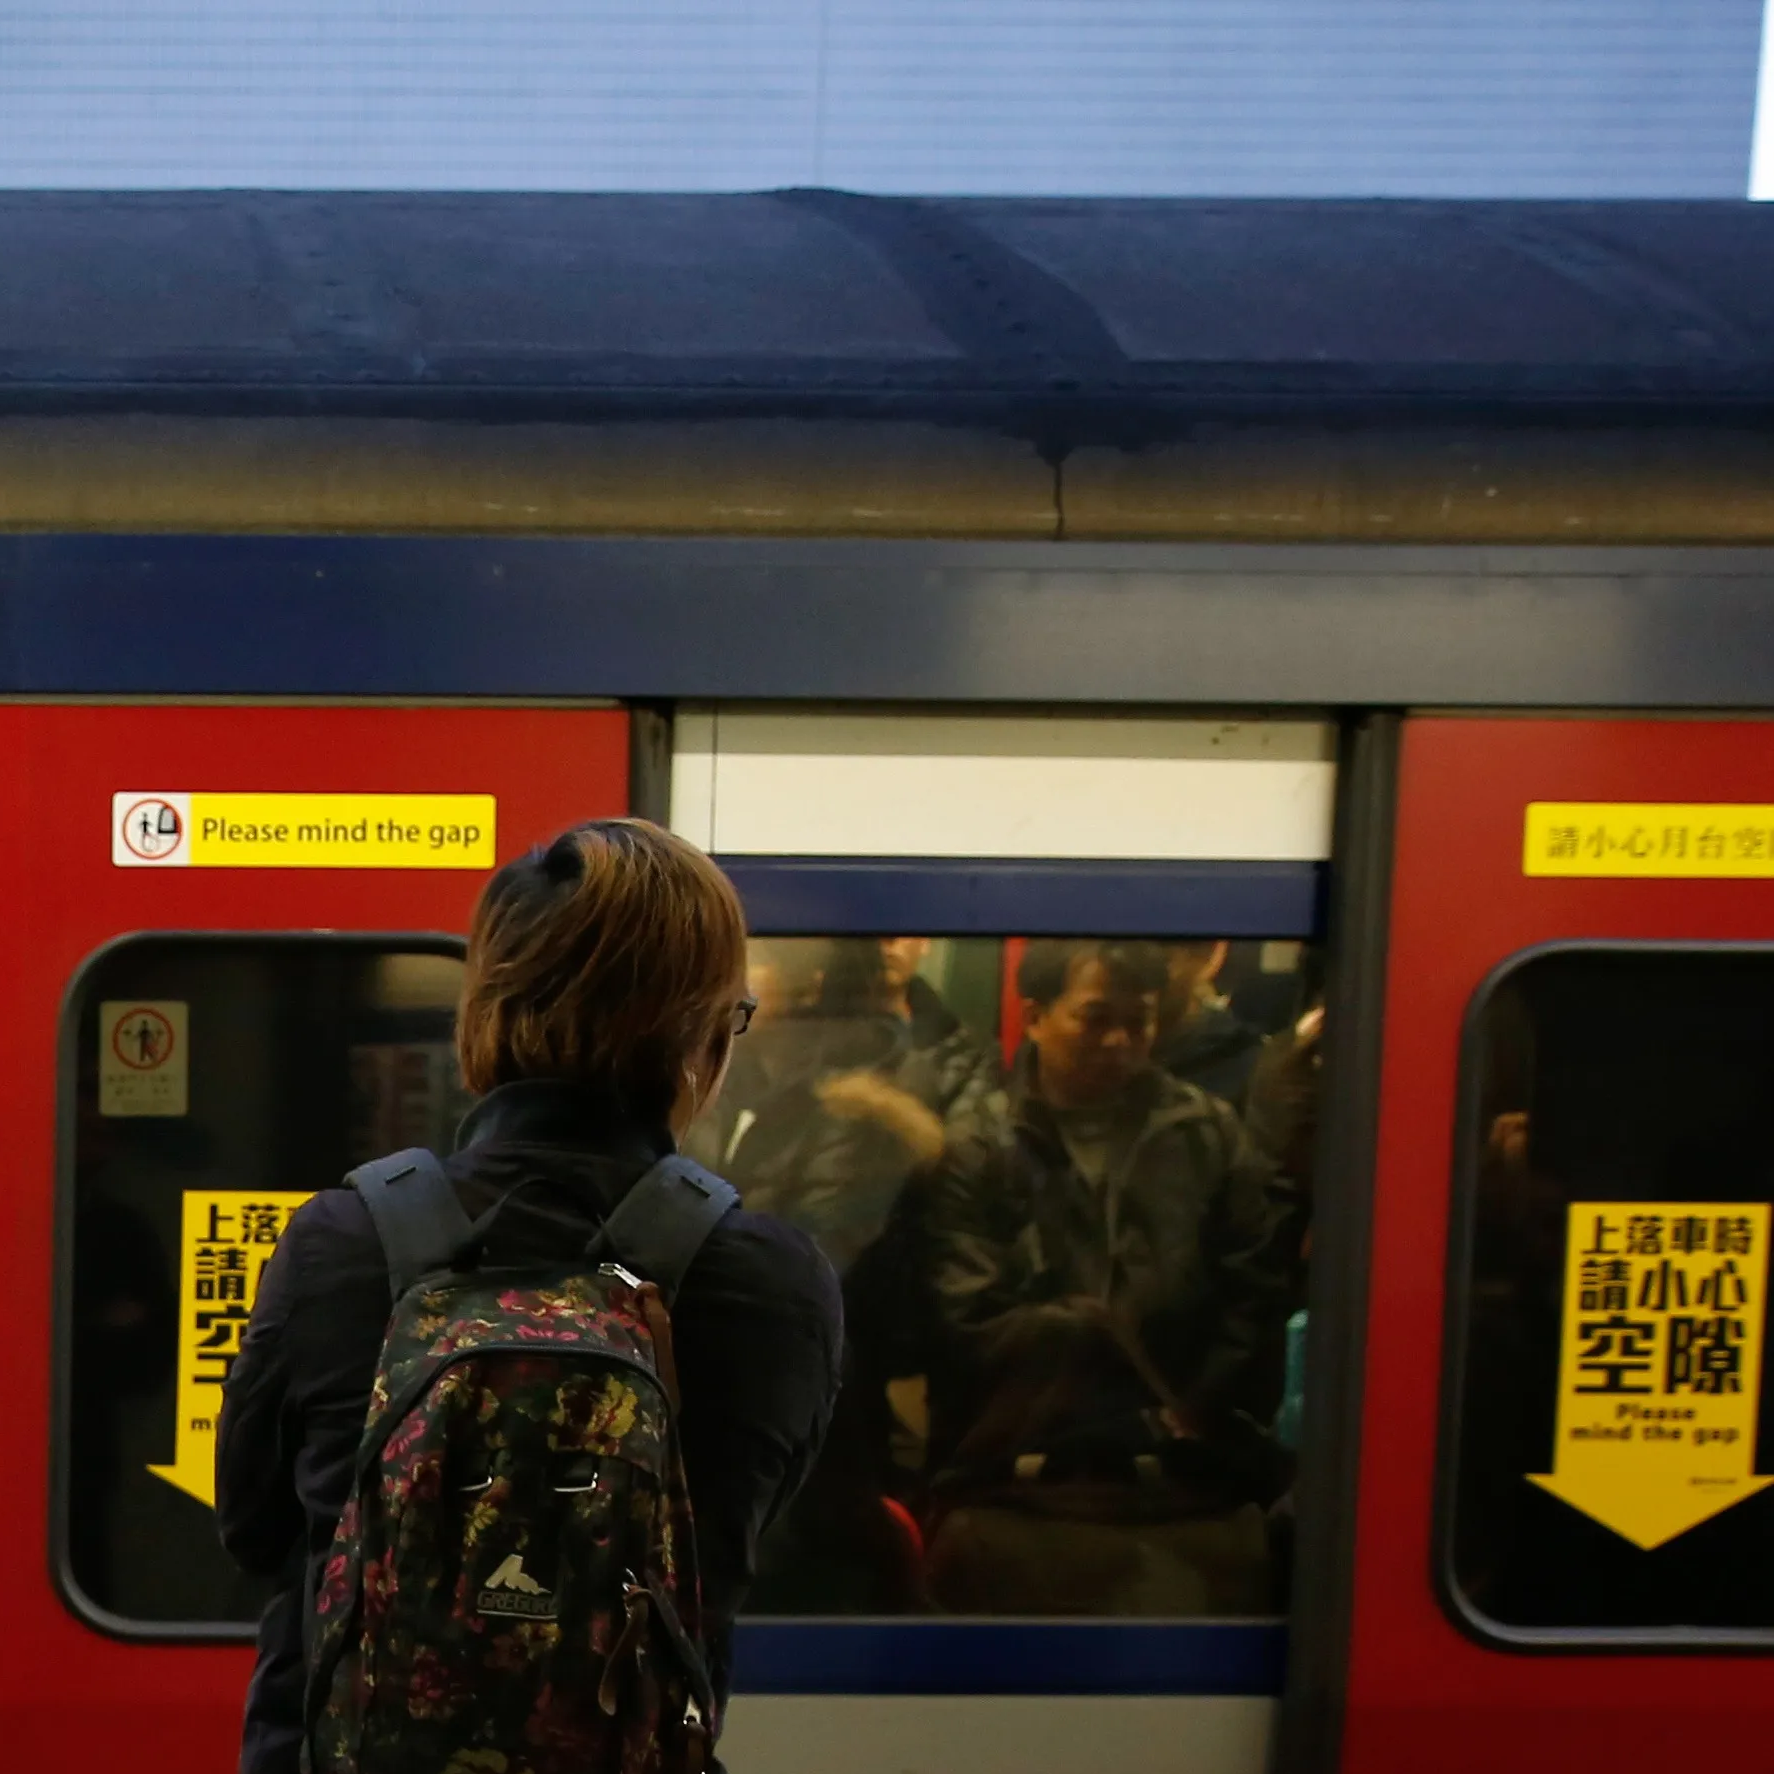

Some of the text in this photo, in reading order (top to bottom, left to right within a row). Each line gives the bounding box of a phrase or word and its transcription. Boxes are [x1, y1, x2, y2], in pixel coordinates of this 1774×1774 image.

[202, 817, 481, 849] Please mind the gap
[1546, 825, 1774, 860] 請小心月台空
[196, 1202, 294, 1244] 上落
[1581, 1215, 1753, 1256] 上落車時
[1579, 1259, 1748, 1313] 請小心
[1574, 1315, 1745, 1395] 空隙
[1615, 1403, 1697, 1422] Please
[1570, 1424, 1741, 1447] mind the gap
